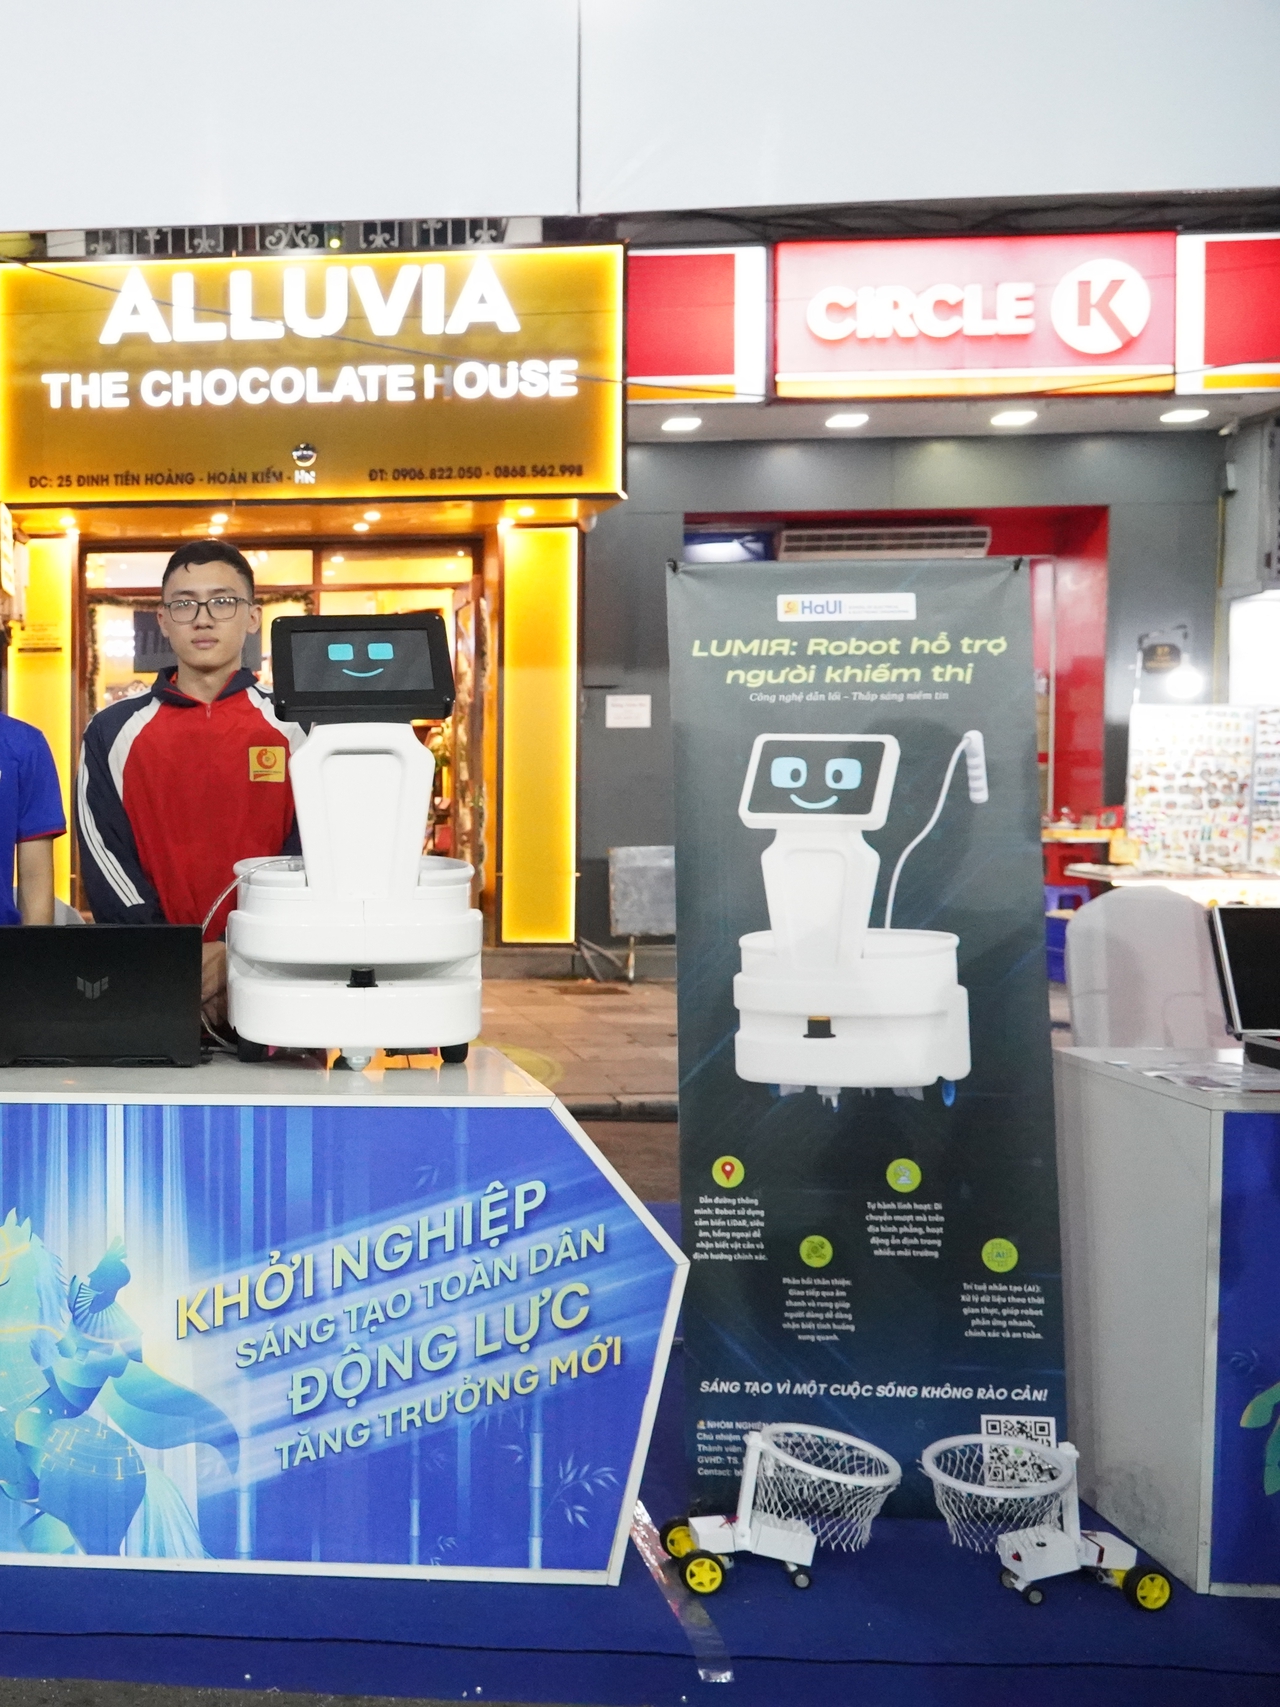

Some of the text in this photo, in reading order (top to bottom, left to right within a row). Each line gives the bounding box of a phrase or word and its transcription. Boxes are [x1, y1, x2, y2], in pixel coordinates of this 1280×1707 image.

[98, 255, 521, 345] ALLUVIA
[805, 279, 1136, 347] CIRCLE K
[41, 359, 579, 409] THE CHOCOLATE HOUSE
[56, 474, 72, 487] 25
[77, 473, 110, 487] ĐINH
[144, 468, 195, 486] HOÀNG
[207, 468, 247, 484] HOÀN
[294, 470, 316, 485] HN
[392, 466, 483, 480] 0906.822.050
[807, 637, 902, 656] Robot
[910, 631, 952, 655] hỗ
[960, 636, 1008, 657] trợ
[725, 663, 975, 688] người khiếm thị
[177, 1180, 547, 1340] KHỞI NGHIỆP
[236, 1223, 605, 1368] SÁNG TẠO TOÀN DÂN
[287, 1282, 590, 1416] ĐỘNG LỰC
[274, 1334, 622, 1471] TĂNG TRƯỞNG MỚI
[699, 1377, 1049, 1402] SÁNG TẠO VÌ MỘT CUỘC SỐNG KHÔNG RÀO CẢN!
